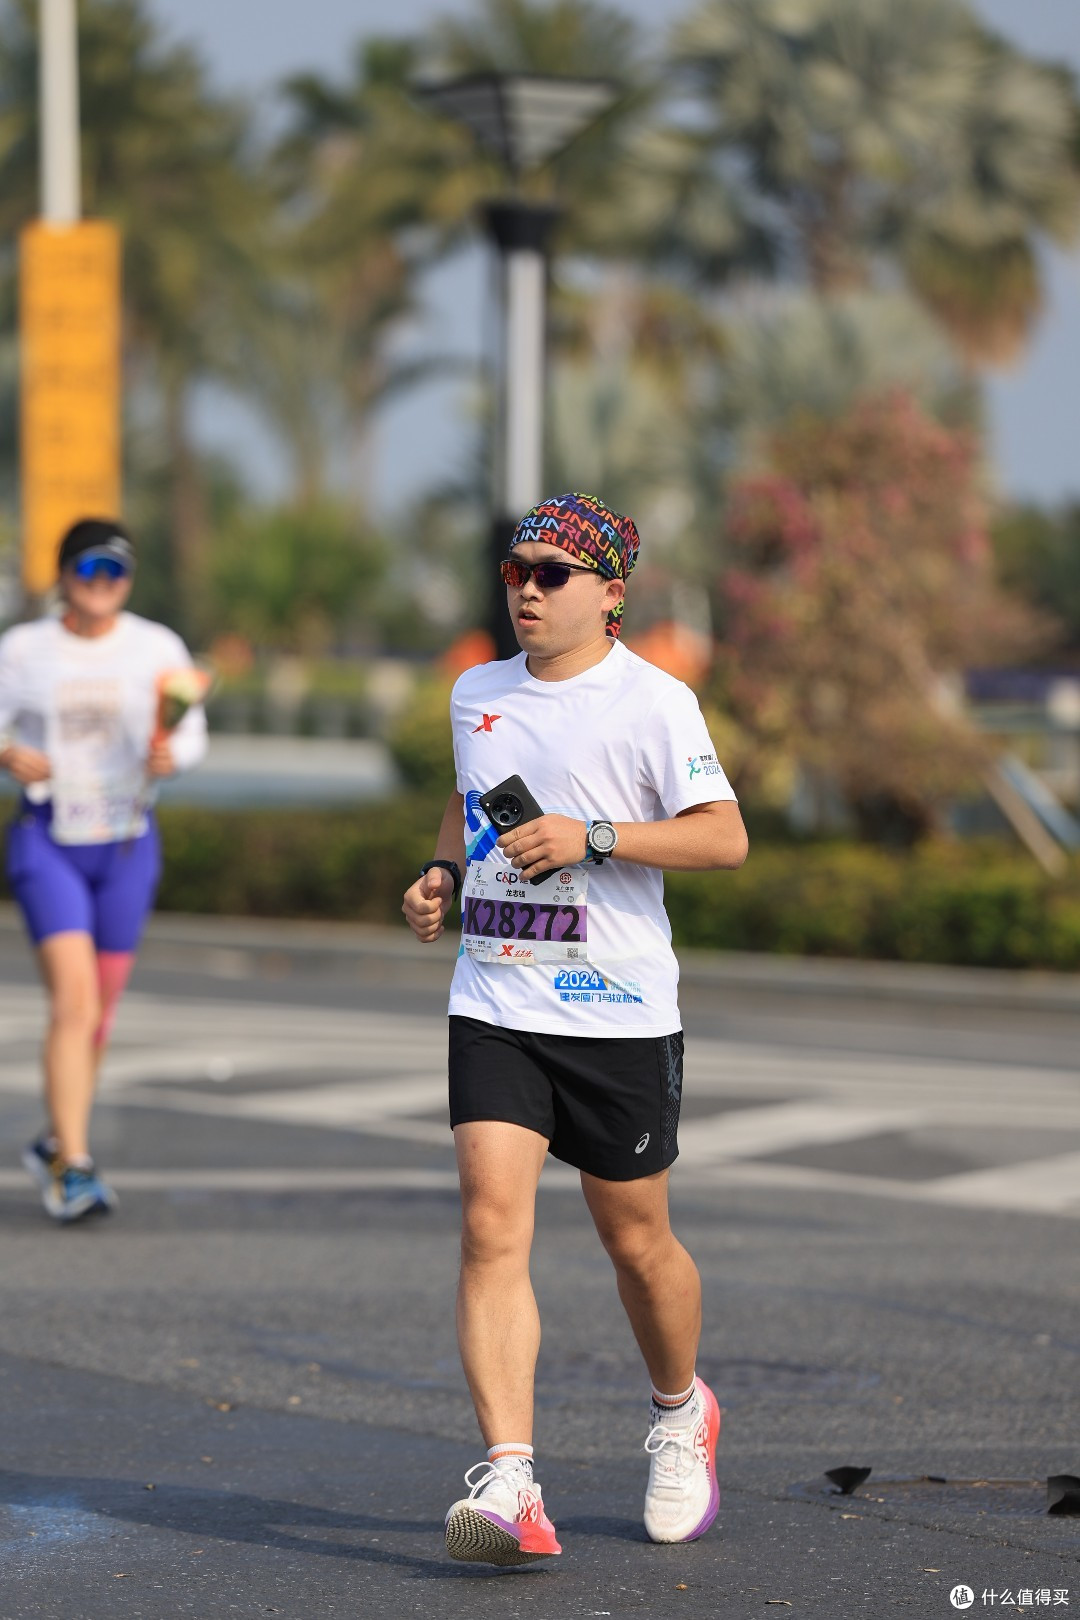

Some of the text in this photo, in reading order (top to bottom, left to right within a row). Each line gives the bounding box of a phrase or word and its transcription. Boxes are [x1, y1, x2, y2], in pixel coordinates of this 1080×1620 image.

[517, 516, 560, 532] RUN
[537, 505, 583, 530] RUN
[495, 871, 518, 885] C&D
[466, 898, 581, 942] K28272
[558, 969, 601, 988] 2024
